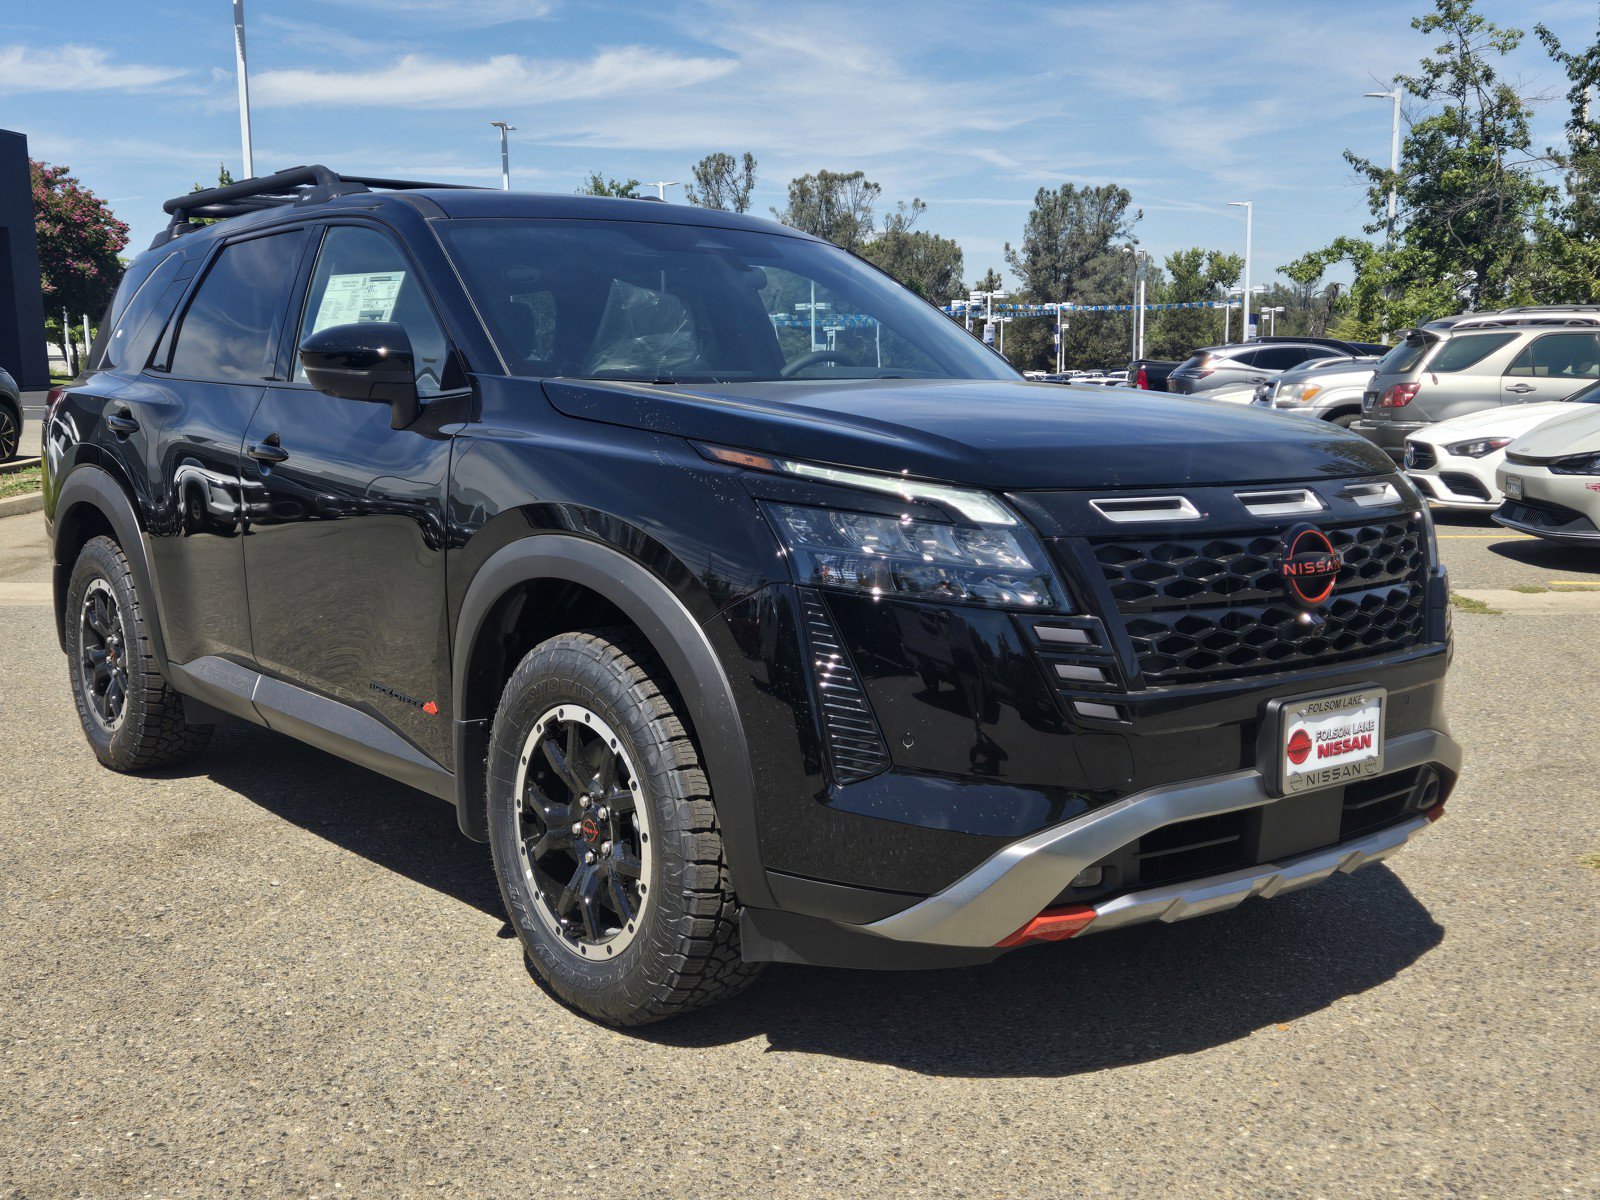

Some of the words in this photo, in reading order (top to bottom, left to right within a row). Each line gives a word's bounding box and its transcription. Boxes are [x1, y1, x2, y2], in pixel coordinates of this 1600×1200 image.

[1283, 559, 1340, 575] NISSAN
[1307, 699, 1341, 714] FOLSOM
[1342, 695, 1364, 707] LAKE
[1316, 725, 1351, 742] FOLSOM
[1352, 720, 1375, 736] LAKE
[1317, 734, 1372, 759] NISSAN
[1306, 763, 1361, 786] NISSAN
